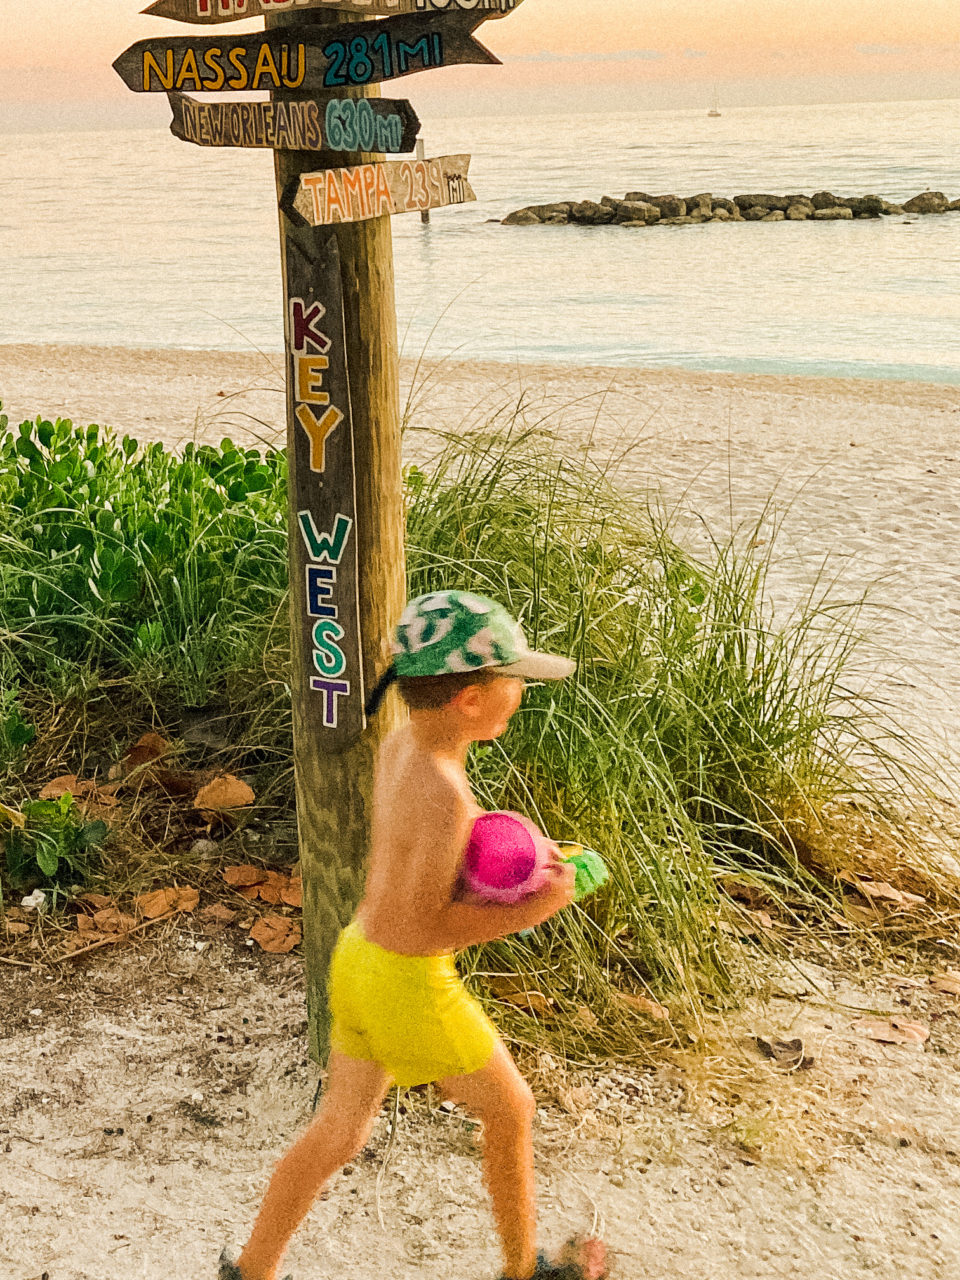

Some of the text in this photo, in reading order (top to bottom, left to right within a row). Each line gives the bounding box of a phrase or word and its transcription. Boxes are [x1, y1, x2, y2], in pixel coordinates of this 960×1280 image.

[141, 31, 443, 91] NASSAU 281 MI
[181, 98, 226, 145] NEW
[229, 100, 322, 151] ORLEANS
[302, 162, 396, 225] TAMPA
[400, 160, 449, 210] 239
[289, 296, 353, 730] KEY WEST
